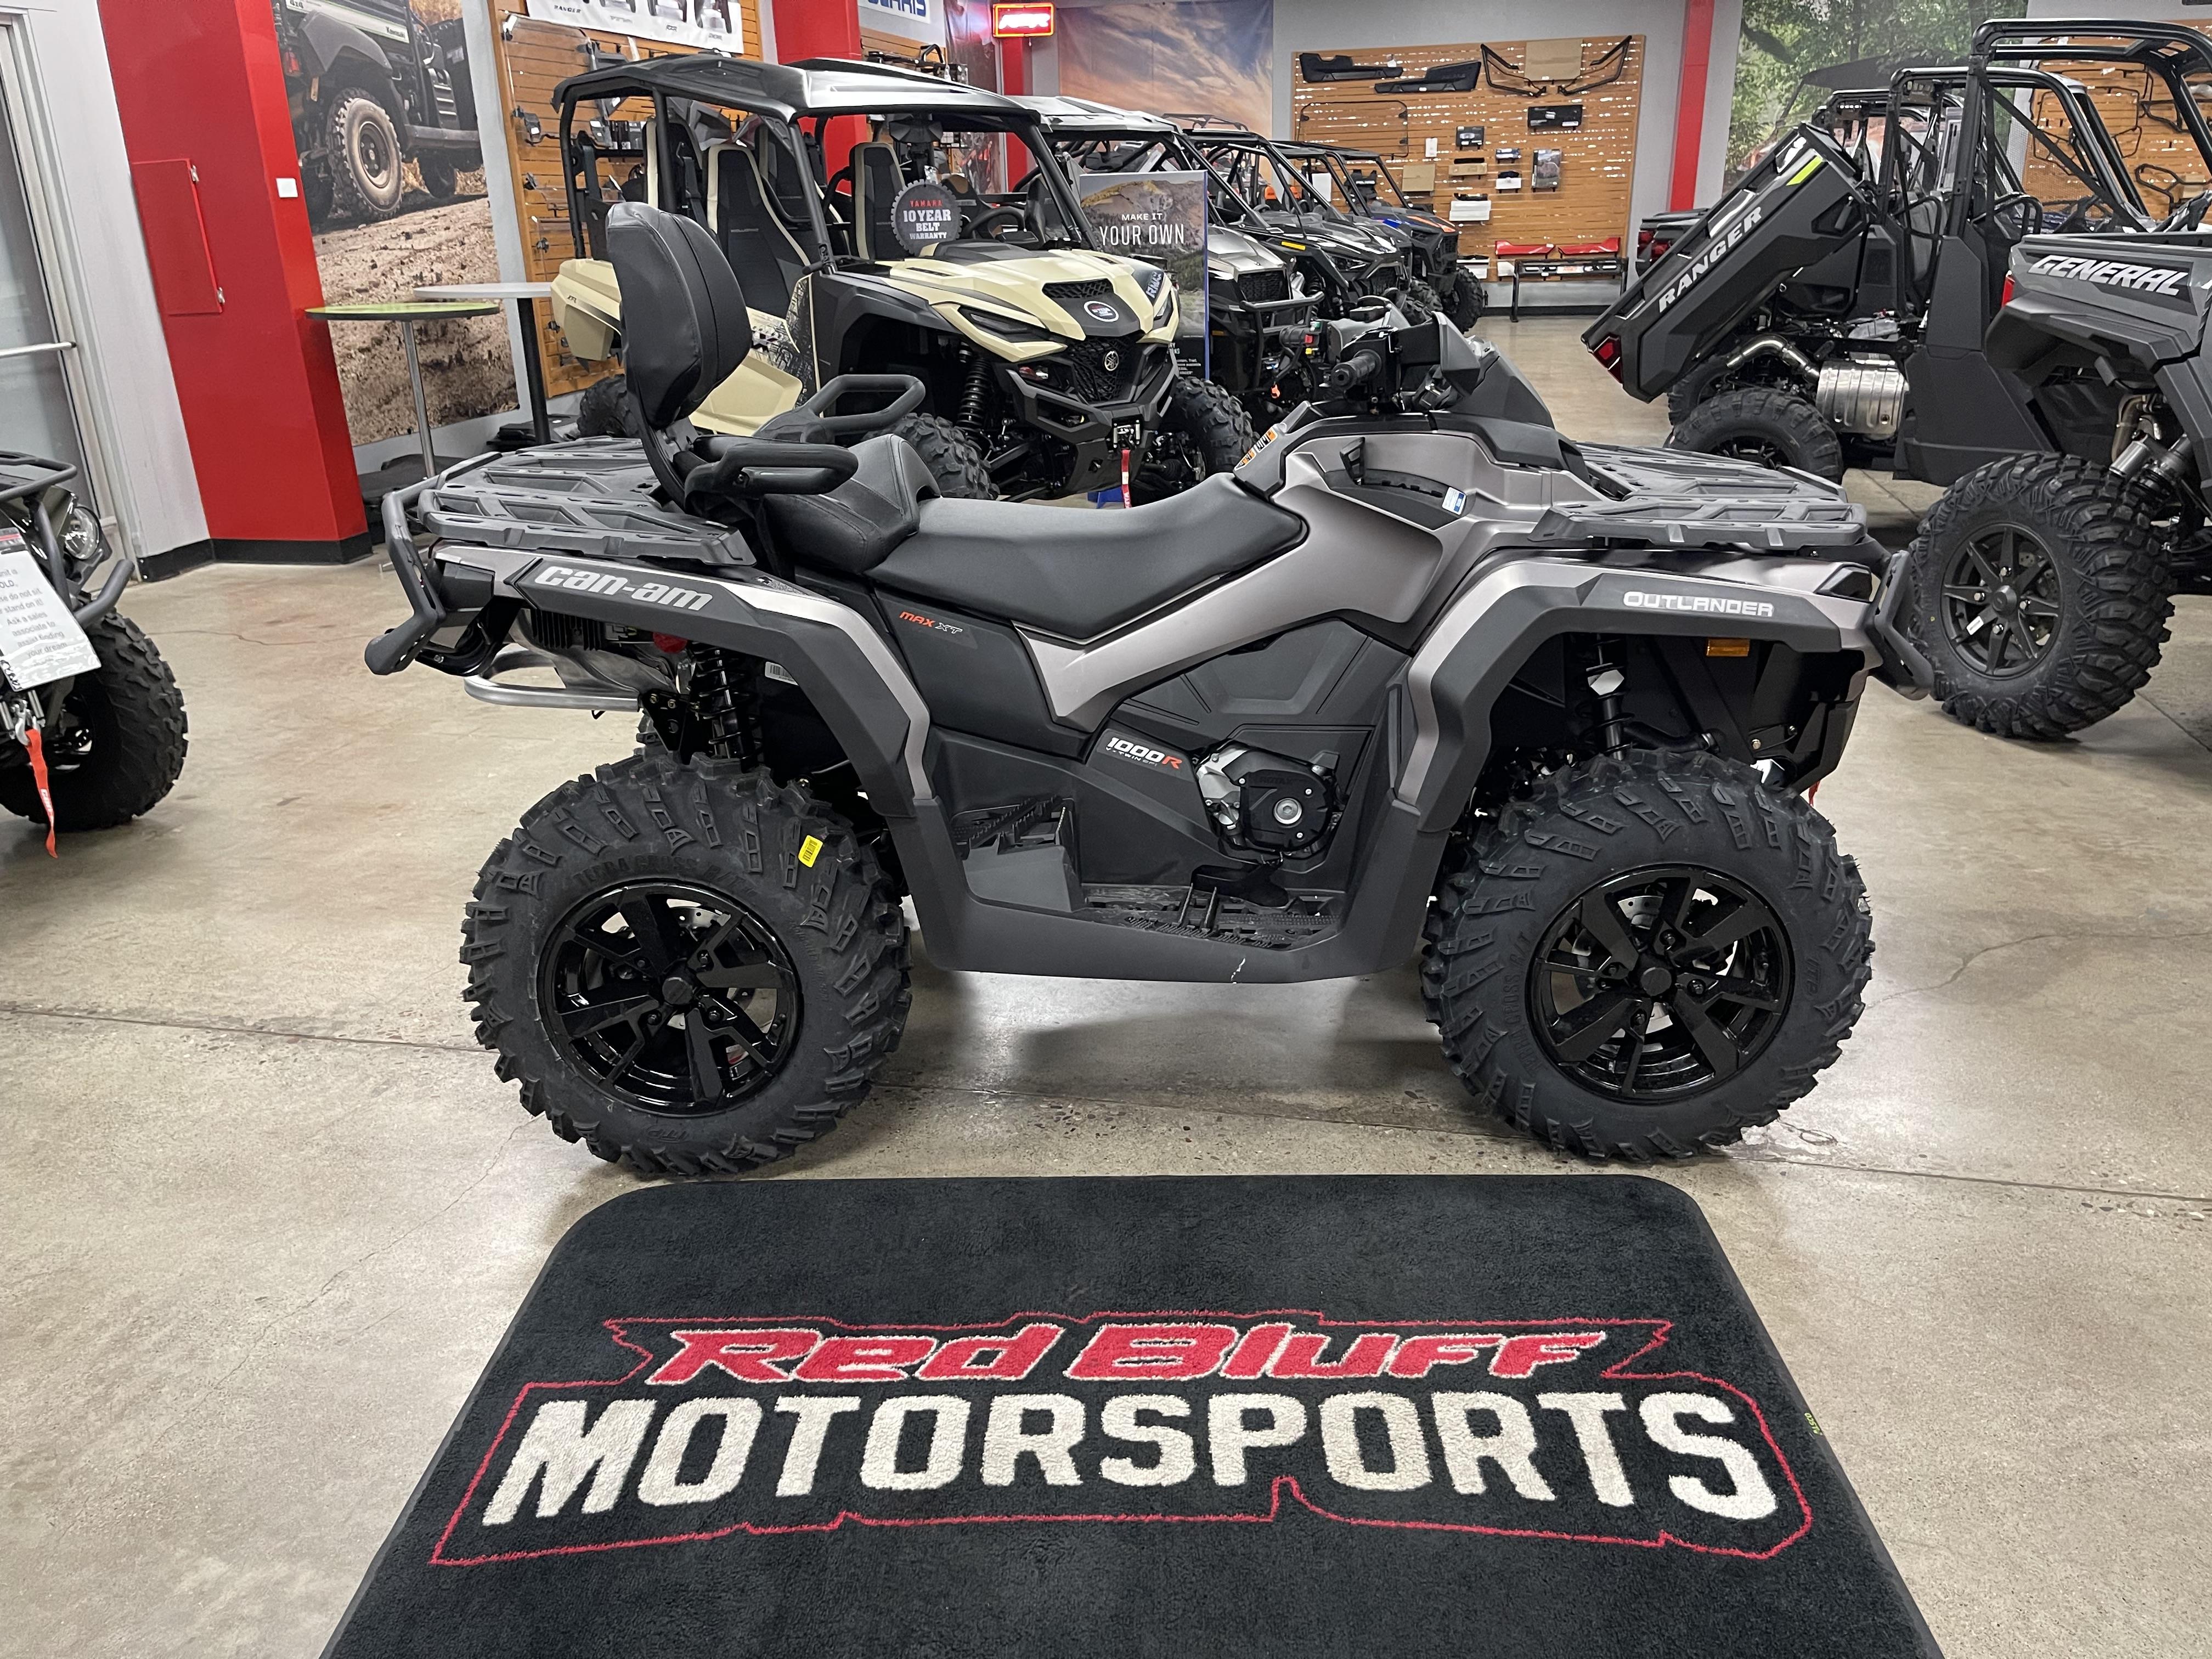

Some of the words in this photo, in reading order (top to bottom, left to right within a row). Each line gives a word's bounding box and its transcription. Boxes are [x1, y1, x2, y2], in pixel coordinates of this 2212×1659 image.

[903, 210, 916, 222] 10
[917, 209, 951, 222] YEAR
[1122, 213, 1149, 221] MAKE
[909, 232, 947, 240] WARRANTY
[916, 222, 940, 232] BELT
[1099, 225, 1142, 246] YOUR
[1149, 224, 1184, 245] OWN
[1659, 207, 1762, 312] RANGER
[2028, 255, 2188, 296] GENERAL
[1623, 591, 1774, 617] OUTLANDER
[7, 616, 22, 625] Ask
[935, 622, 963, 634] XT
[1107, 737, 1182, 769] 1000R
[645, 1322, 1066, 1386] Red
[482, 1388, 1778, 1526] MOTORSPORTS
